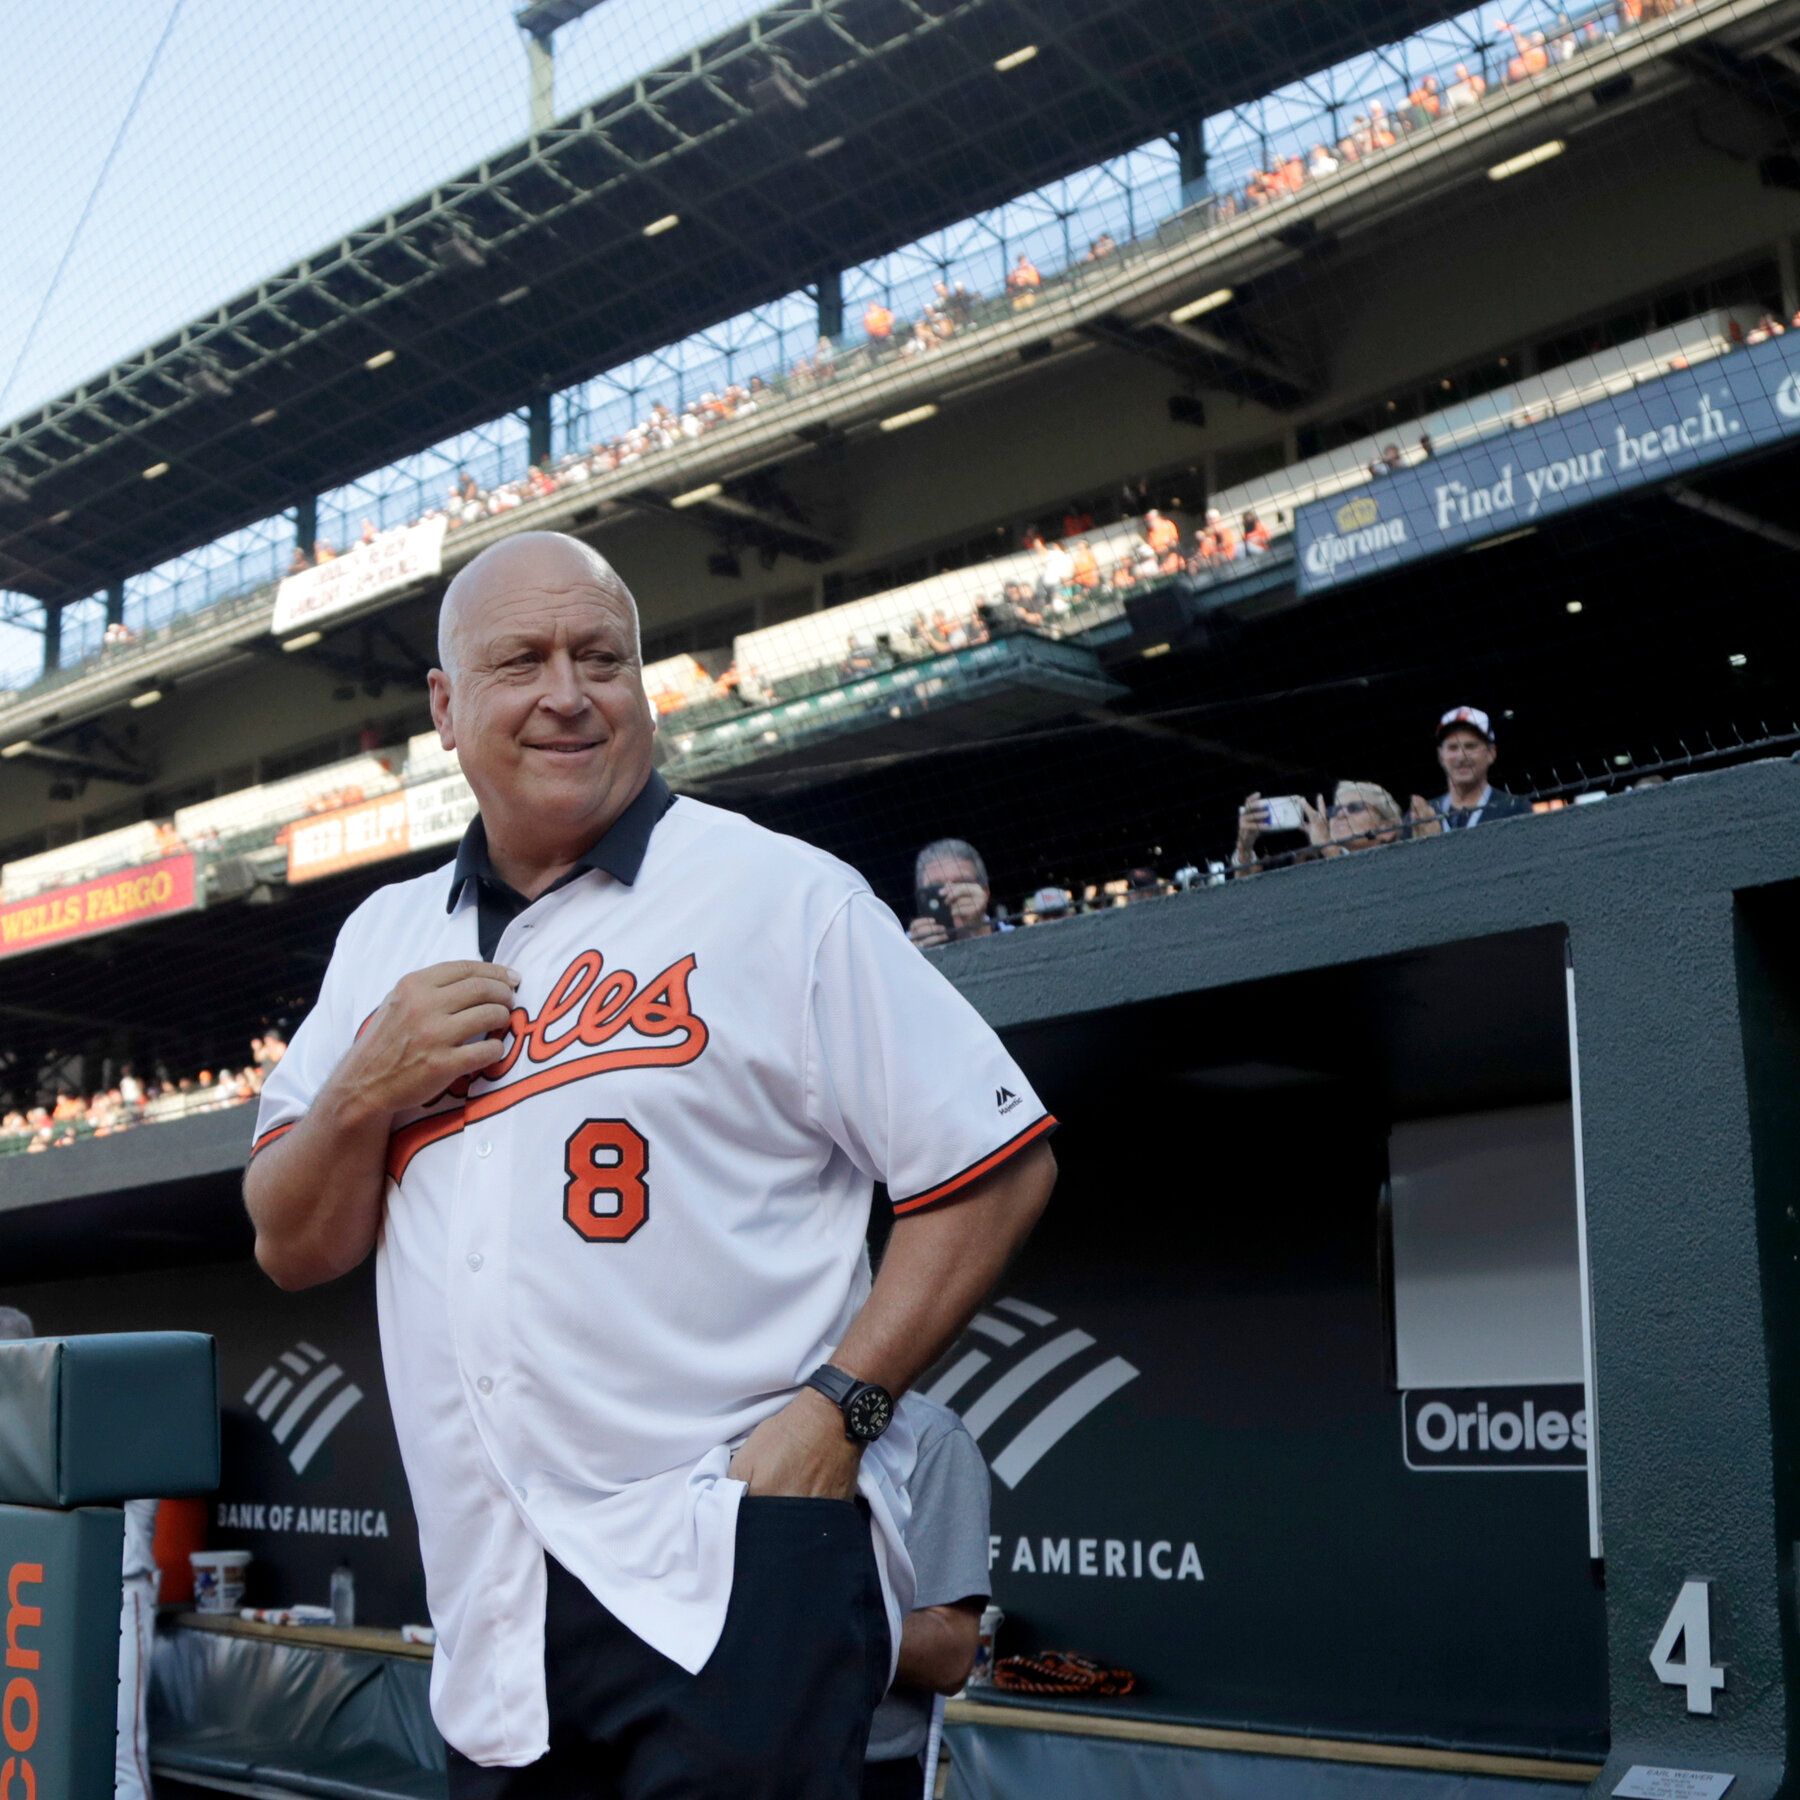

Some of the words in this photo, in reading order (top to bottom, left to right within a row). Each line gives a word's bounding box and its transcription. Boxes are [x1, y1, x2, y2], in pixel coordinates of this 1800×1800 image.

[1434, 462, 1516, 530] Find
[1525, 448, 1607, 517] your
[1615, 393, 1741, 470] beach.
[1304, 517, 1408, 576] Corona
[1, 895, 82, 944] WELLS
[86, 870, 173, 922] FARGO
[562, 1118, 650, 1243] 8
[217, 1503, 266, 1530] BANK
[268, 1505, 294, 1531] OF
[295, 1507, 389, 1538] AMERICA
[1011, 1536, 1205, 1581] AMERICA
[1649, 1581, 1725, 1714] 4
[1674, 1771, 1714, 1782] WEAVER
